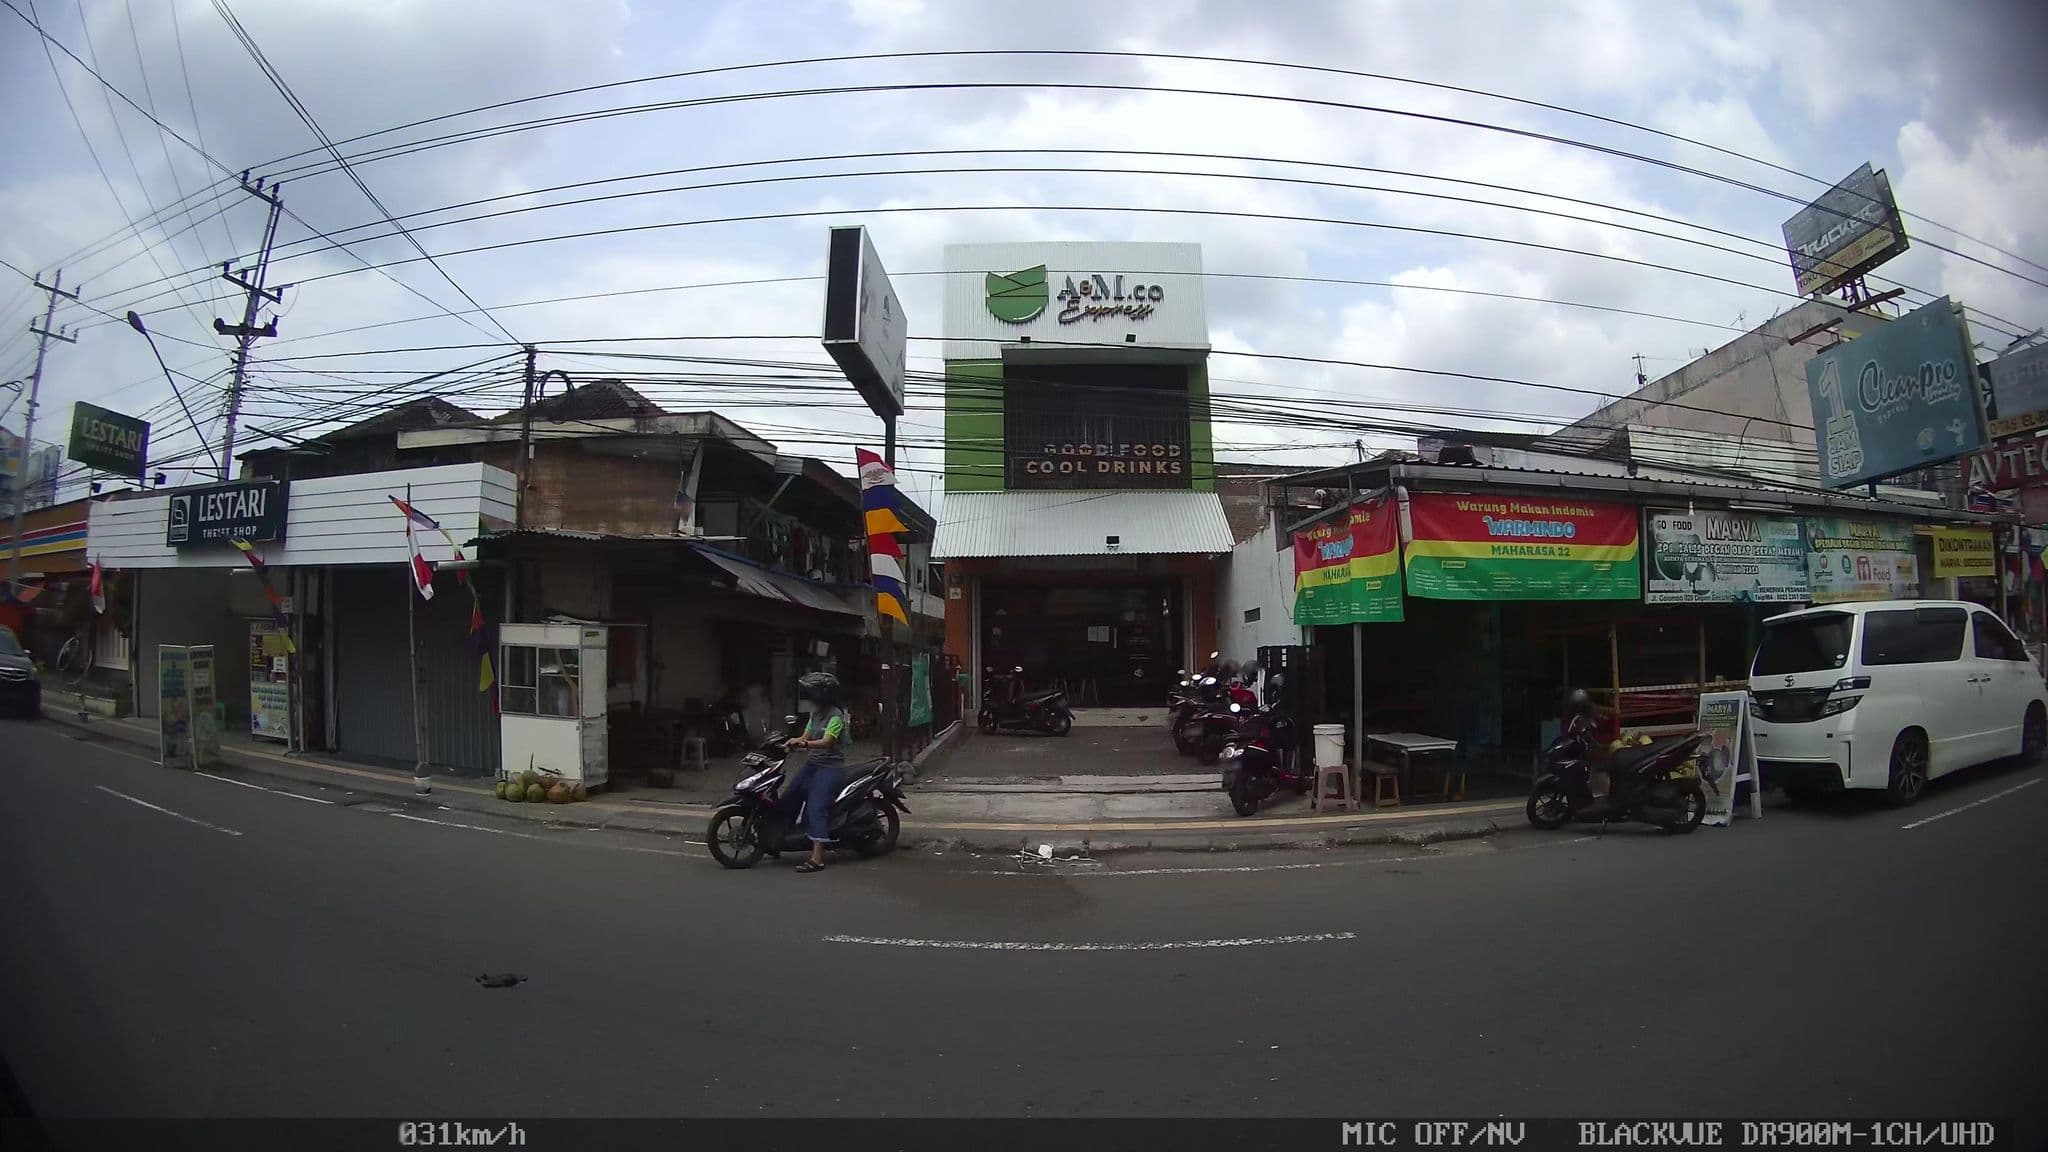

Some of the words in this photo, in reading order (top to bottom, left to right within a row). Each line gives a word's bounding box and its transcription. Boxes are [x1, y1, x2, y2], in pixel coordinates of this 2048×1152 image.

[1058, 300, 1154, 324] Express
[82, 416, 143, 452] LESTARI
[1045, 443, 1108, 457] GOOD
[1120, 443, 1181, 457] FOOD
[1026, 460, 1088, 474] COOL
[1098, 460, 1182, 474] DRINKS
[1831, 450, 1861, 475] SIAP
[199, 488, 267, 522] LESTARI
[1456, 500, 1507, 514] Warung
[1510, 502, 1550, 515] Makan
[1552, 504, 1595, 517] Indomie
[233, 525, 257, 536] SHOP
[1482, 515, 1576, 538] WARMINDO
[1673, 520, 1693, 531] FOOD
[1706, 517, 1761, 542] MARVA
[1491, 545, 1555, 556] MAHARASA
[1558, 546, 1571, 557] 22
